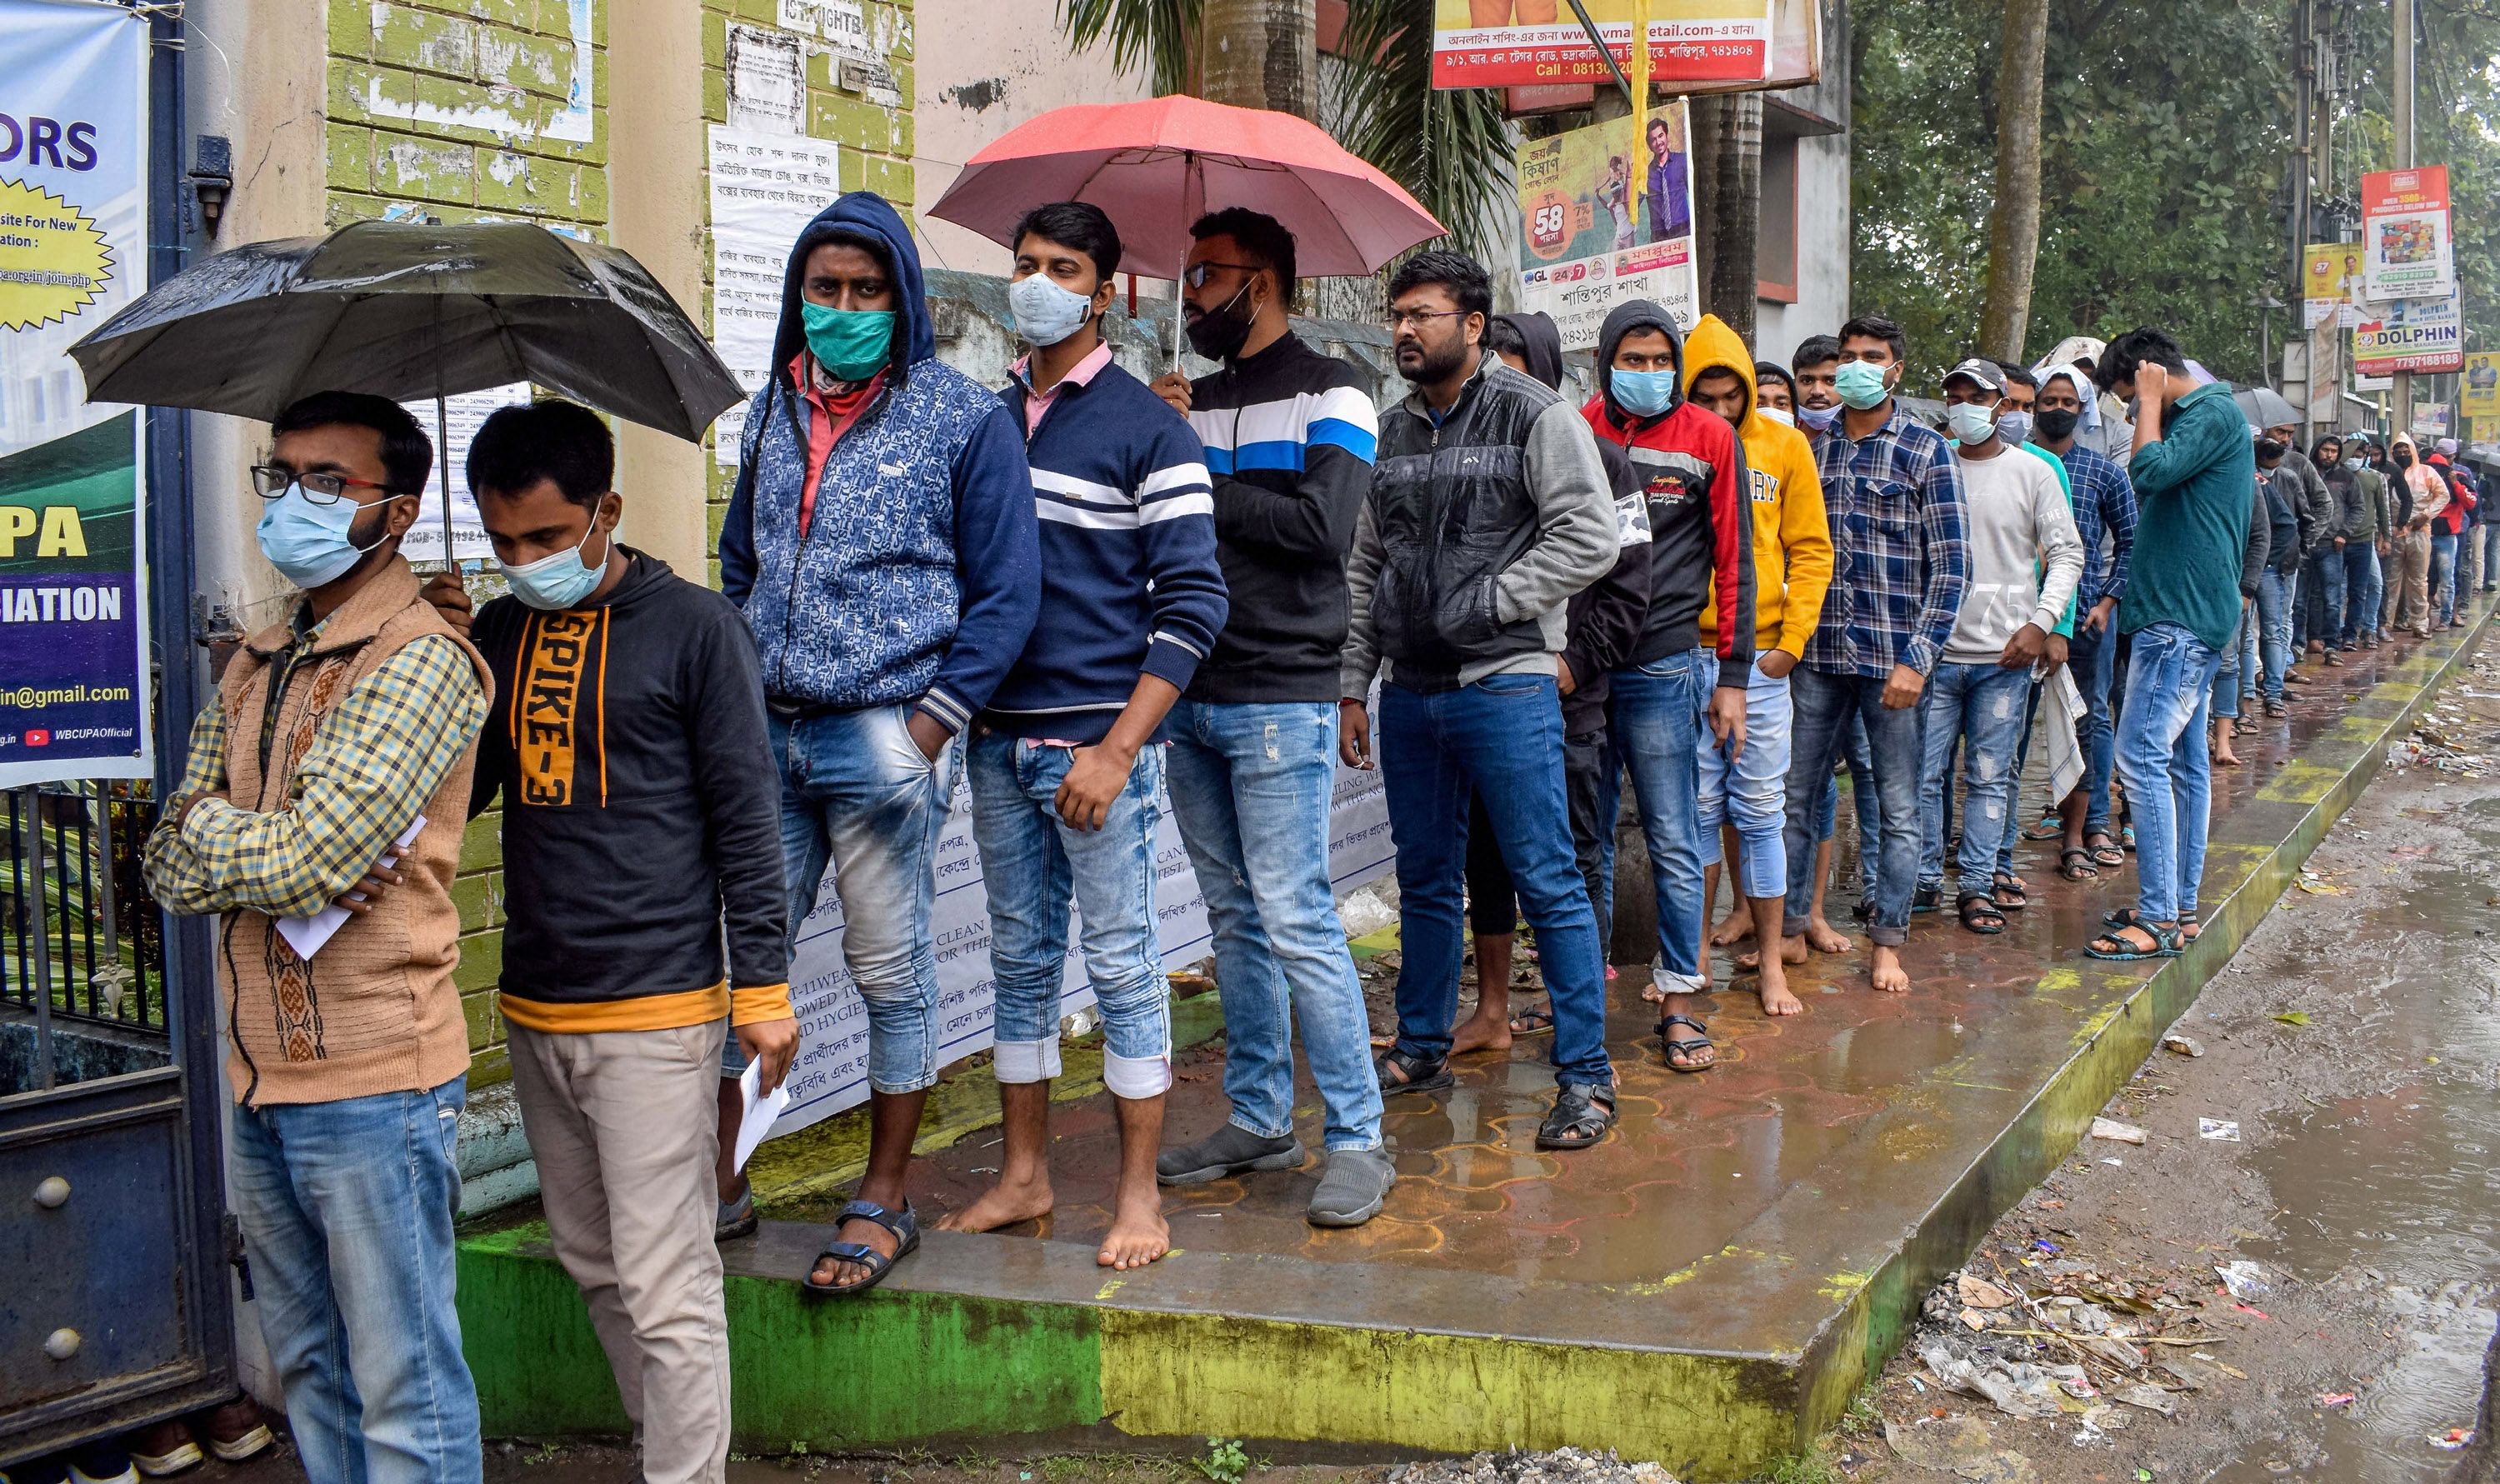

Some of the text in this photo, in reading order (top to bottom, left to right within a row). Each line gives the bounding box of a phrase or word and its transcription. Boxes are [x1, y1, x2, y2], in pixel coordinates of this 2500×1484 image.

[1448, 33, 1489, 46] অনলাইন
[1492, 31, 1533, 44] শপিং-এর
[1538, 31, 1558, 42] জন্য
[1469, 54, 1488, 66] আর.
[1492, 53, 1507, 65] এন.
[1510, 50, 1532, 62] টেগর
[1536, 50, 1558, 62] রোড,
[1669, 42, 1708, 61] শান্তিপুর,
[1711, 44, 1753, 57] ৭৪১৪০৪
[1536, 63, 1561, 77] Call
[716, 140, 830, 167] উৎসব হোক শব্দ দানব মুক্ত।
[1529, 147, 1546, 162] জয়
[717, 162, 748, 176] অতিরিক্ত
[752, 167, 772, 179] মাত্রায়
[1522, 156, 1560, 181] কিষাণ
[1544, 174, 1559, 186] লোন
[718, 186, 830, 208] বক্সের ব্যবহার থেকে বিরত থাকুন।
[1544, 192, 1555, 205] সুদ
[2372, 204, 2402, 213] PRODUCTS
[2404, 202, 2425, 211] BELOW
[26, 216, 46, 228] For
[50, 217, 77, 231] New
[1533, 202, 1565, 236] 58
[1540, 231, 1559, 244] পয়সা
[719, 250, 738, 261] বাজির
[743, 254, 766, 264] ব্যবহারে
[719, 267, 738, 278] জনিত
[739, 272, 761, 282] সমস্যা,
[719, 288, 732, 298] তাই
[735, 291, 752, 302] আসুন
[1561, 276, 1648, 307] শান্তিপুর শাখা
[735, 307, 752, 318] বাজির
[2378, 326, 2457, 346] DOLPHIN
[2393, 342, 2412, 350] HOTEL
[2414, 339, 2456, 348] MANAGEMENT
[2396, 353, 2459, 368] 7797188188
[0, 587, 121, 622] IATION
[0, 686, 129, 708] in@gmail.com
[526, 612, 588, 806] SPIKE-3
[55, 727, 132, 741] WBCUPAOfficial
[1345, 791, 1365, 807] THE
[1346, 830, 1368, 847] ভিতর
[1158, 898, 1187, 924] লিখিত
[936, 919, 984, 947] CLEAN
[934, 935, 991, 963] OR THE
[947, 1012, 972, 1032] মেনে
[803, 1037, 849, 1066] প্রার্থীদের
[830, 1062, 856, 1079] এবং
